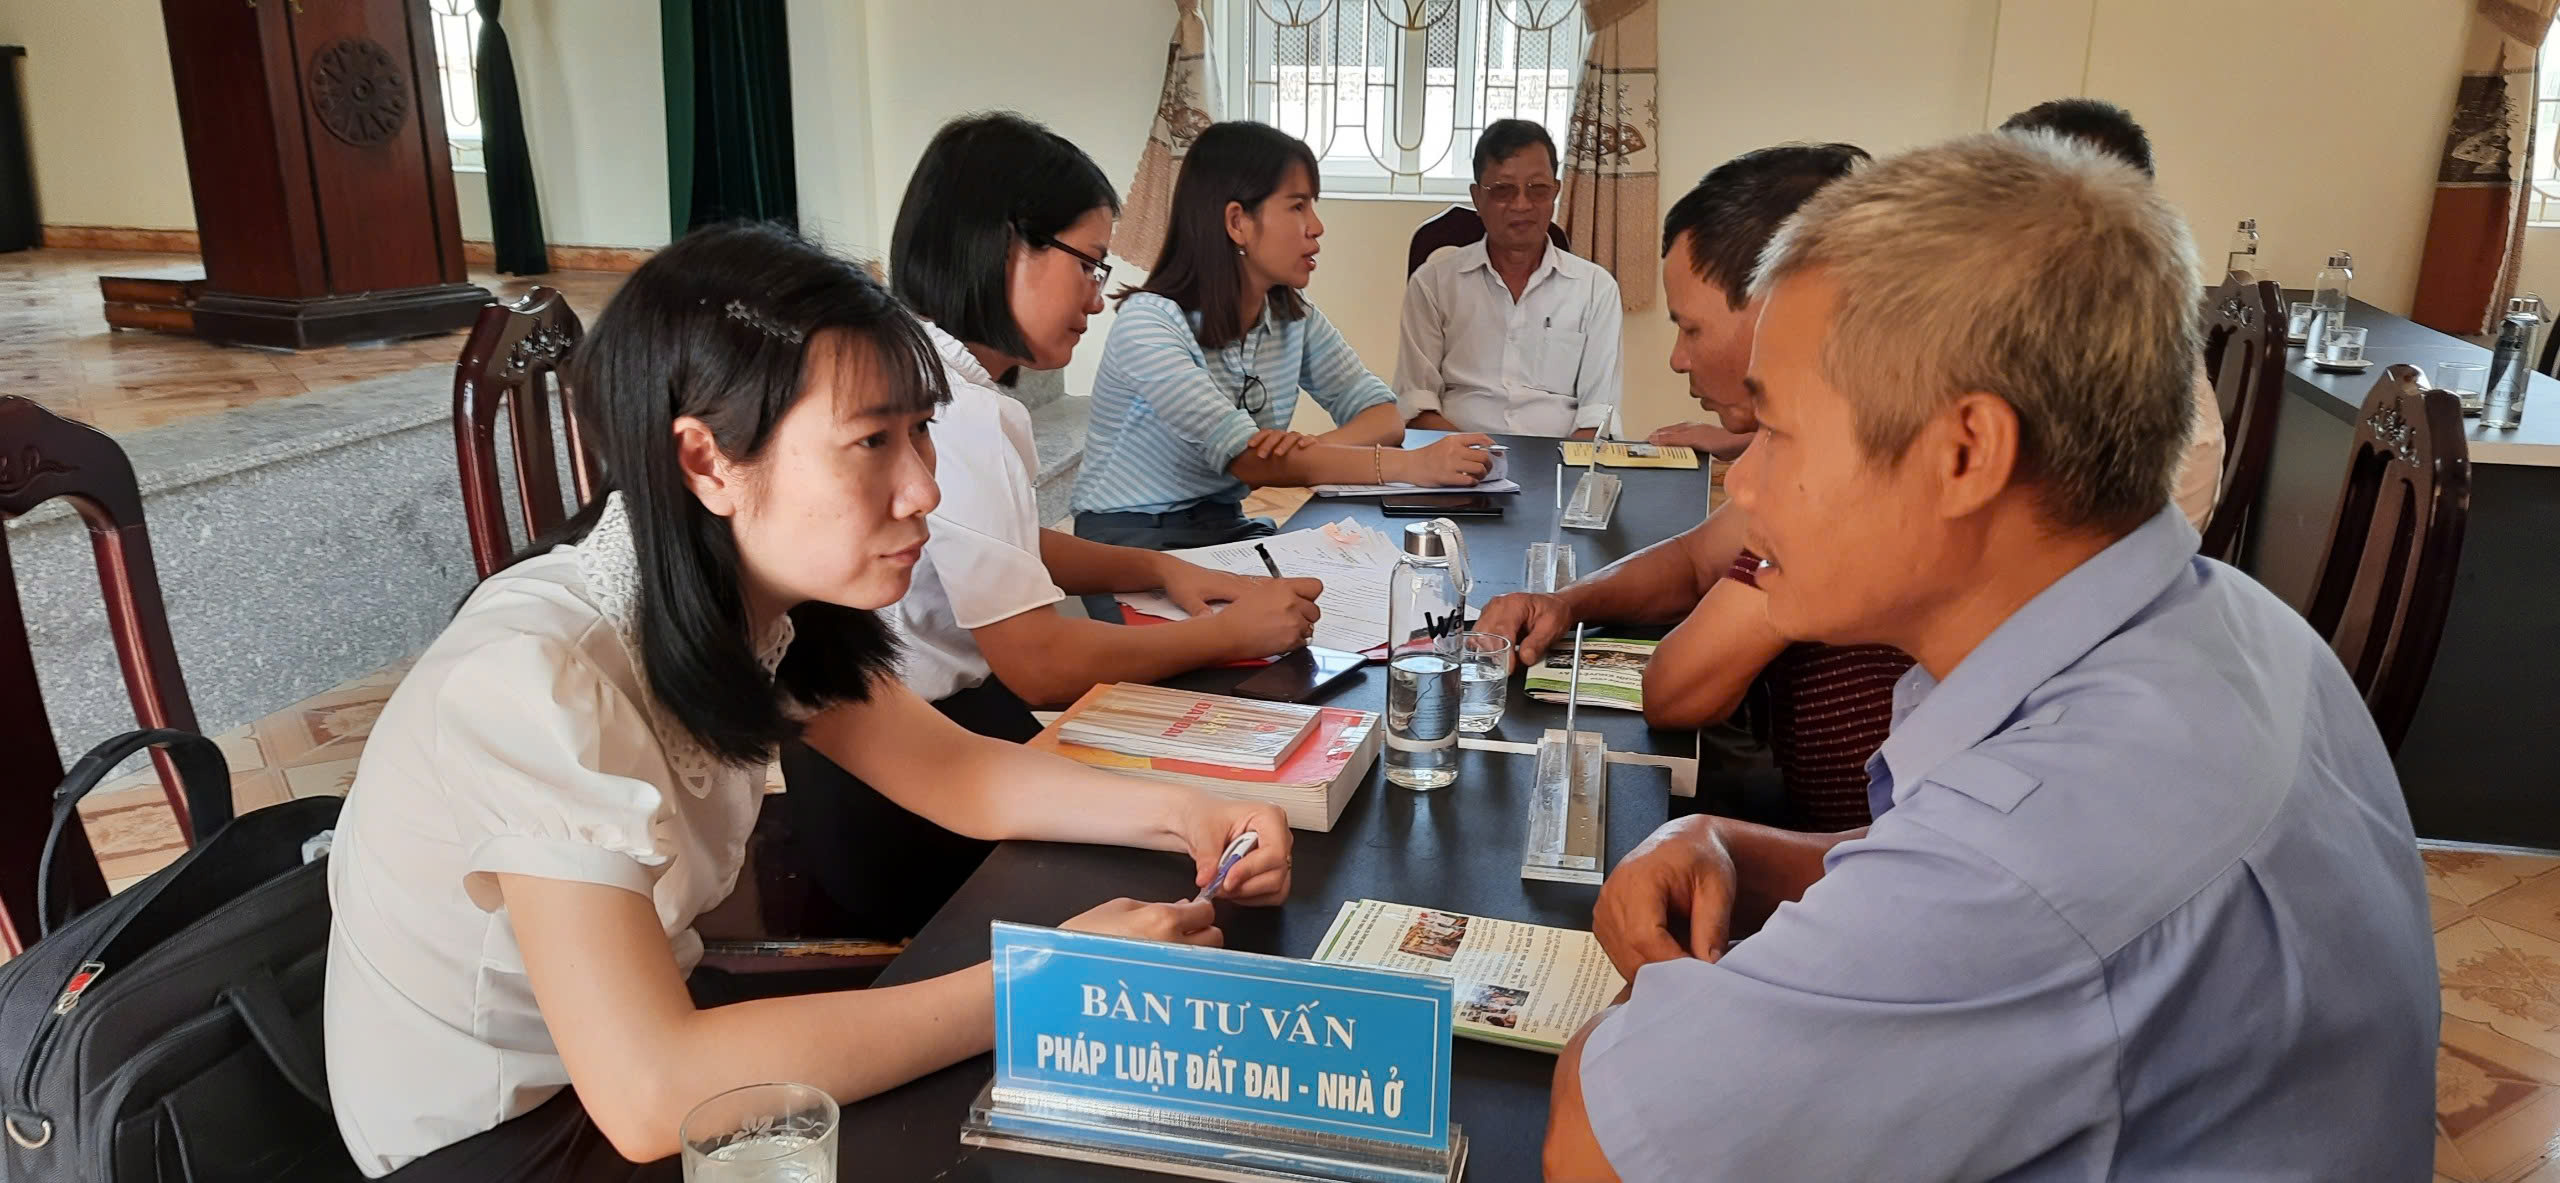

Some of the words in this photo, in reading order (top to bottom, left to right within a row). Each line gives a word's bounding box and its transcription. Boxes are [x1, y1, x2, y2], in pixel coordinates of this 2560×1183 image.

[1081, 979, 1173, 1026] BÀN
[1185, 998, 1252, 1036] TƯ
[1260, 1000, 1356, 1051] VẤN
[1037, 1031, 1107, 1076] PHÁP
[1115, 1041, 1179, 1092] LUẬT
[1185, 1045, 1237, 1094] ĐẤT
[1244, 1061, 1290, 1102] ĐAI
[1317, 1070, 1375, 1115] NHÀ
[1383, 1066, 1404, 1118] Ở
